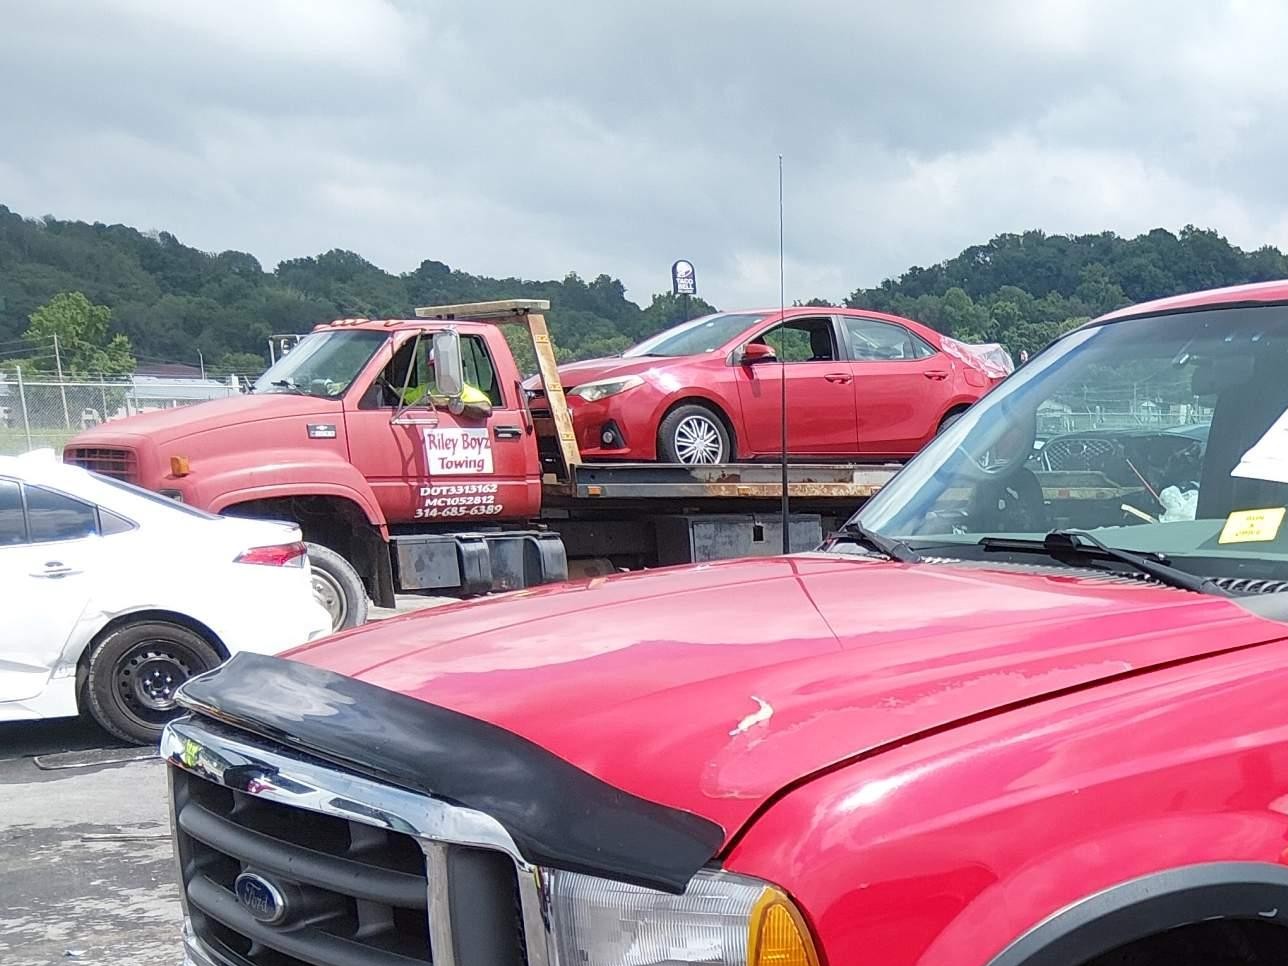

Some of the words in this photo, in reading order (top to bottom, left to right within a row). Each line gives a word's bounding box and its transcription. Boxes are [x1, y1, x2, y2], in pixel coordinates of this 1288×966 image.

[427, 433, 459, 455] Riley
[461, 433, 491, 455] Boyz
[438, 457, 485, 472] Towing
[420, 484, 498, 496] DOT3313162
[425, 495, 495, 506] MC1052812
[414, 504, 503, 518] 314-685-6389
[244, 881, 268, 913] Ford
